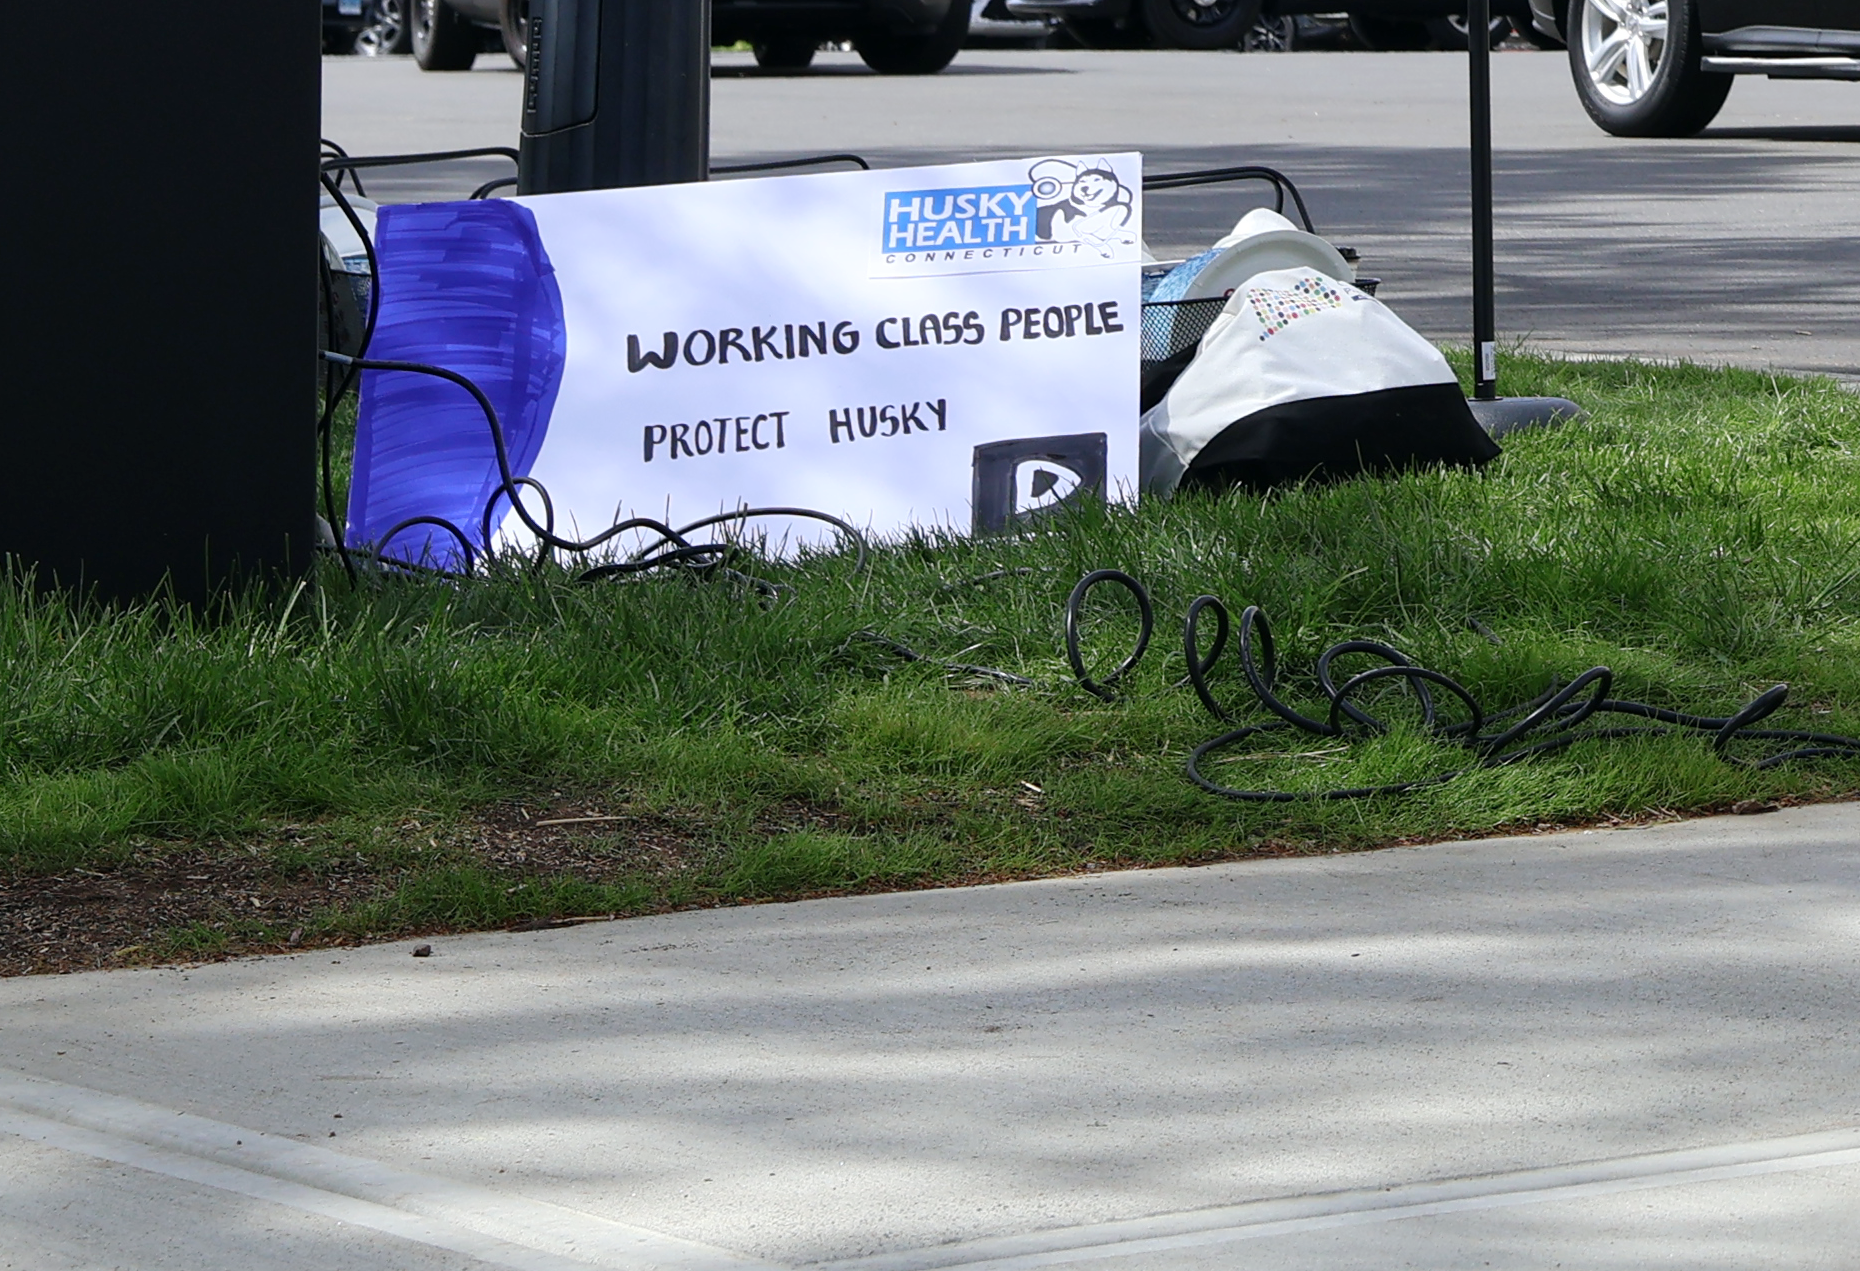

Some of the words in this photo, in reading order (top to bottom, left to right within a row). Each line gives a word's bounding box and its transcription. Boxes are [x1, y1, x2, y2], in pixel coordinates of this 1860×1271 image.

[888, 190, 1033, 223] HUSKY
[887, 217, 1029, 249] HEALTH
[885, 243, 1082, 264] CONNECTICUT
[627, 321, 861, 373] WORKING
[875, 310, 985, 351] CLASS
[999, 300, 1124, 344] PEOPLE
[643, 410, 790, 463] PROTECT
[828, 398, 948, 446] HUSKY
